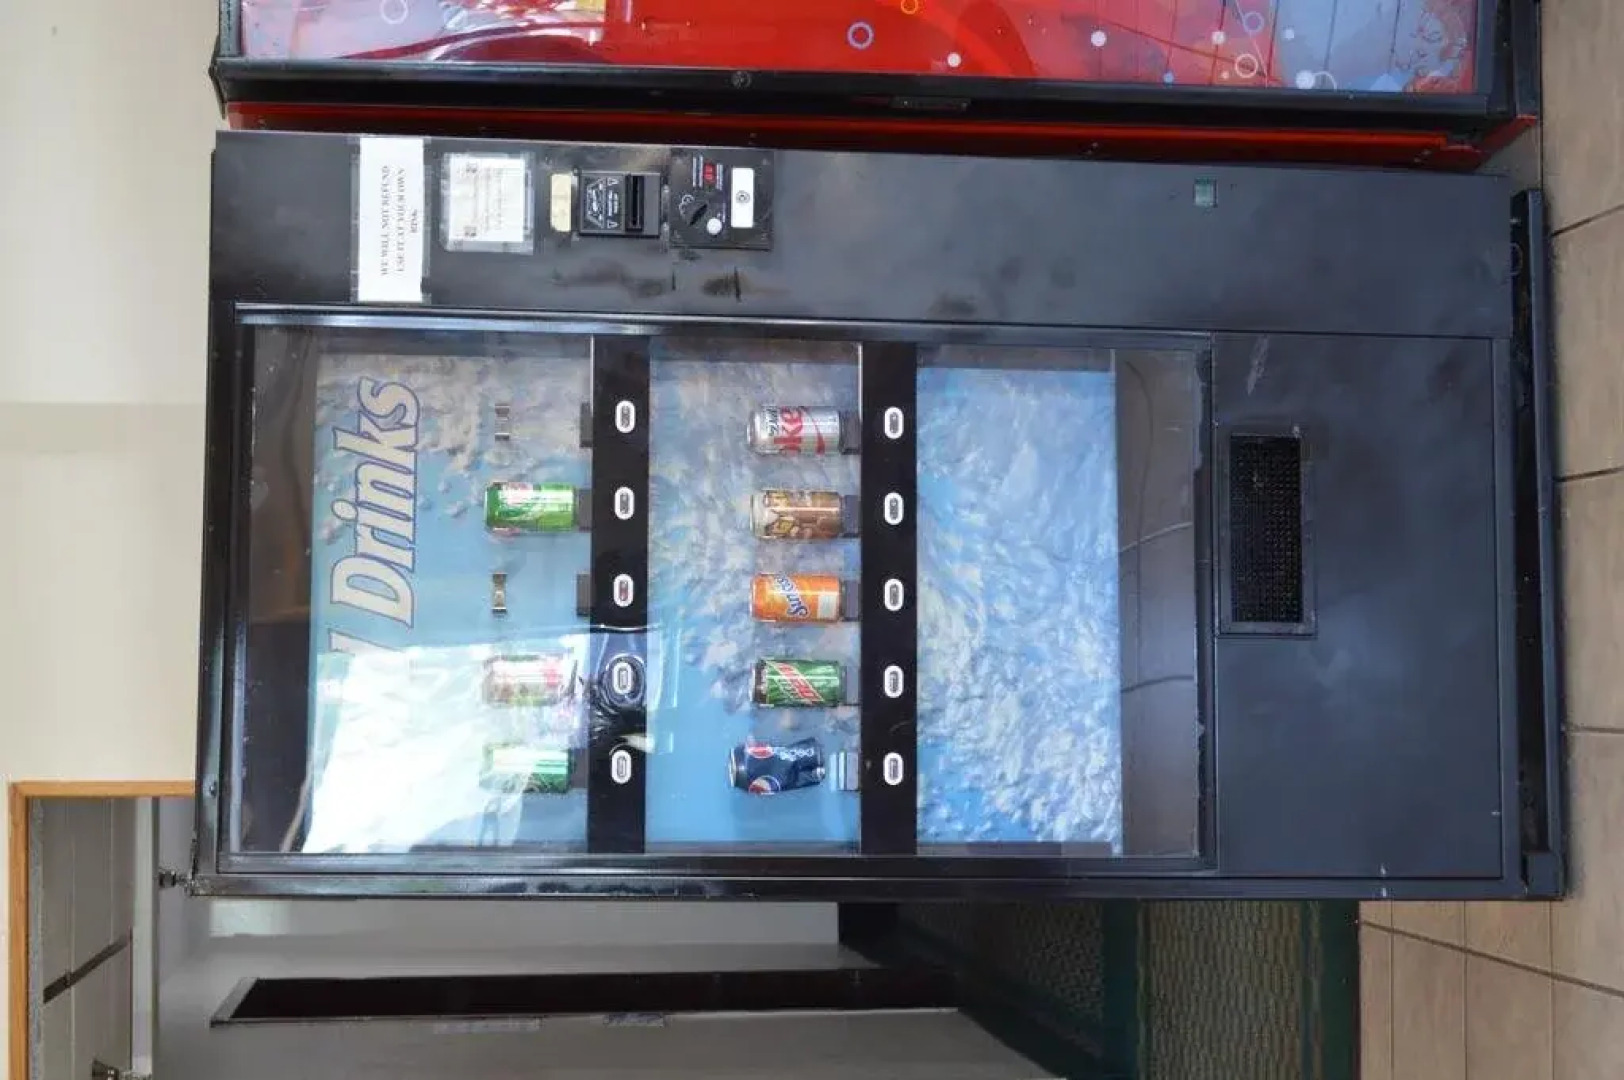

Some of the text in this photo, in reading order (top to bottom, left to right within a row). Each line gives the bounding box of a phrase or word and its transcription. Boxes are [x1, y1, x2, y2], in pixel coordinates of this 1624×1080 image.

[396, 168, 406, 193] OWN
[381, 208, 389, 230] NOT
[380, 232, 389, 258] WILL
[380, 261, 389, 276] WE
[329, 378, 420, 630] Drinks
